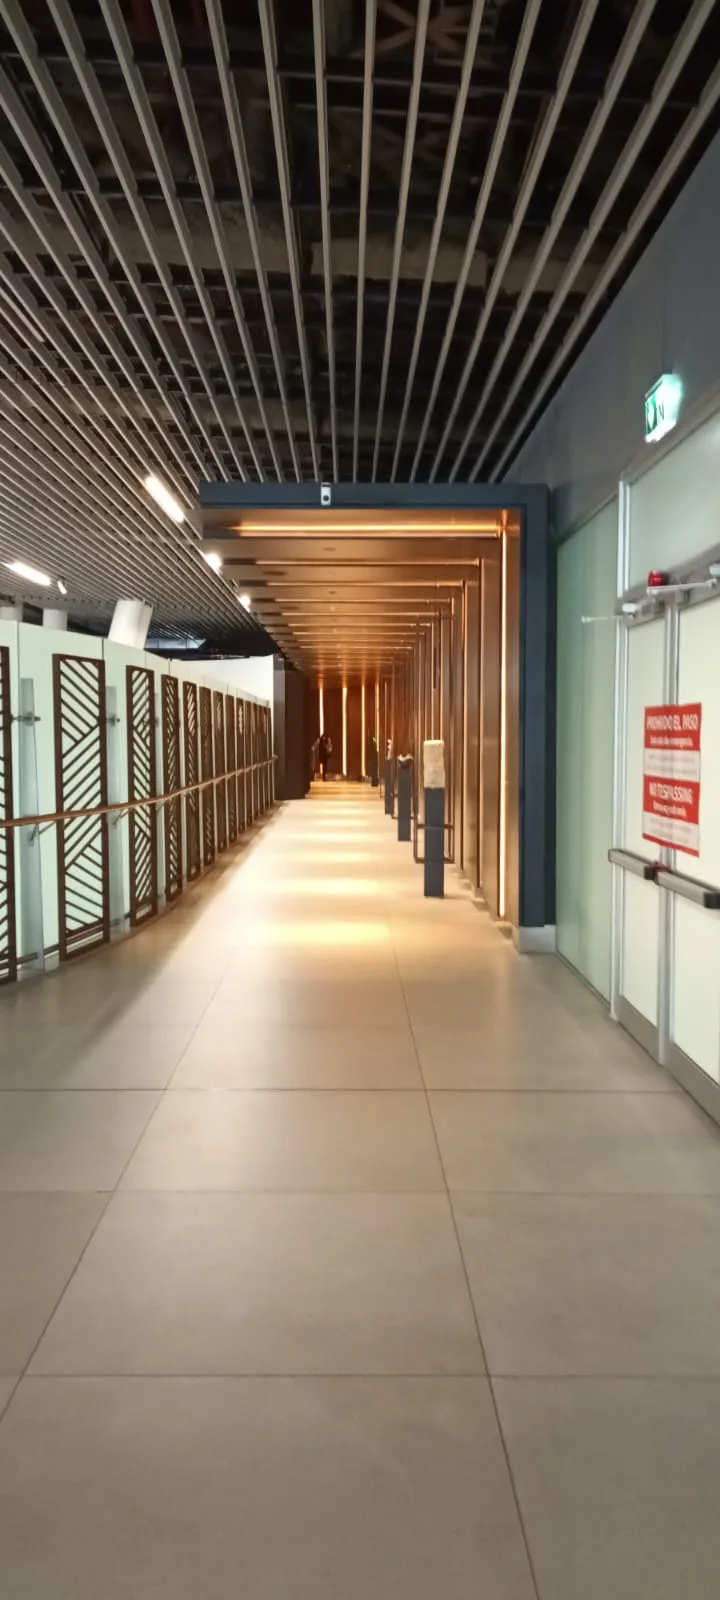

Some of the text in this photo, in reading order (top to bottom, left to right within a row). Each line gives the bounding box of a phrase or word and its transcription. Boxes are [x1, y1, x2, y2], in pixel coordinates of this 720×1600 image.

[673, 714, 682, 731] EL
[682, 713, 698, 731] PASO
[648, 782, 657, 798] NO
